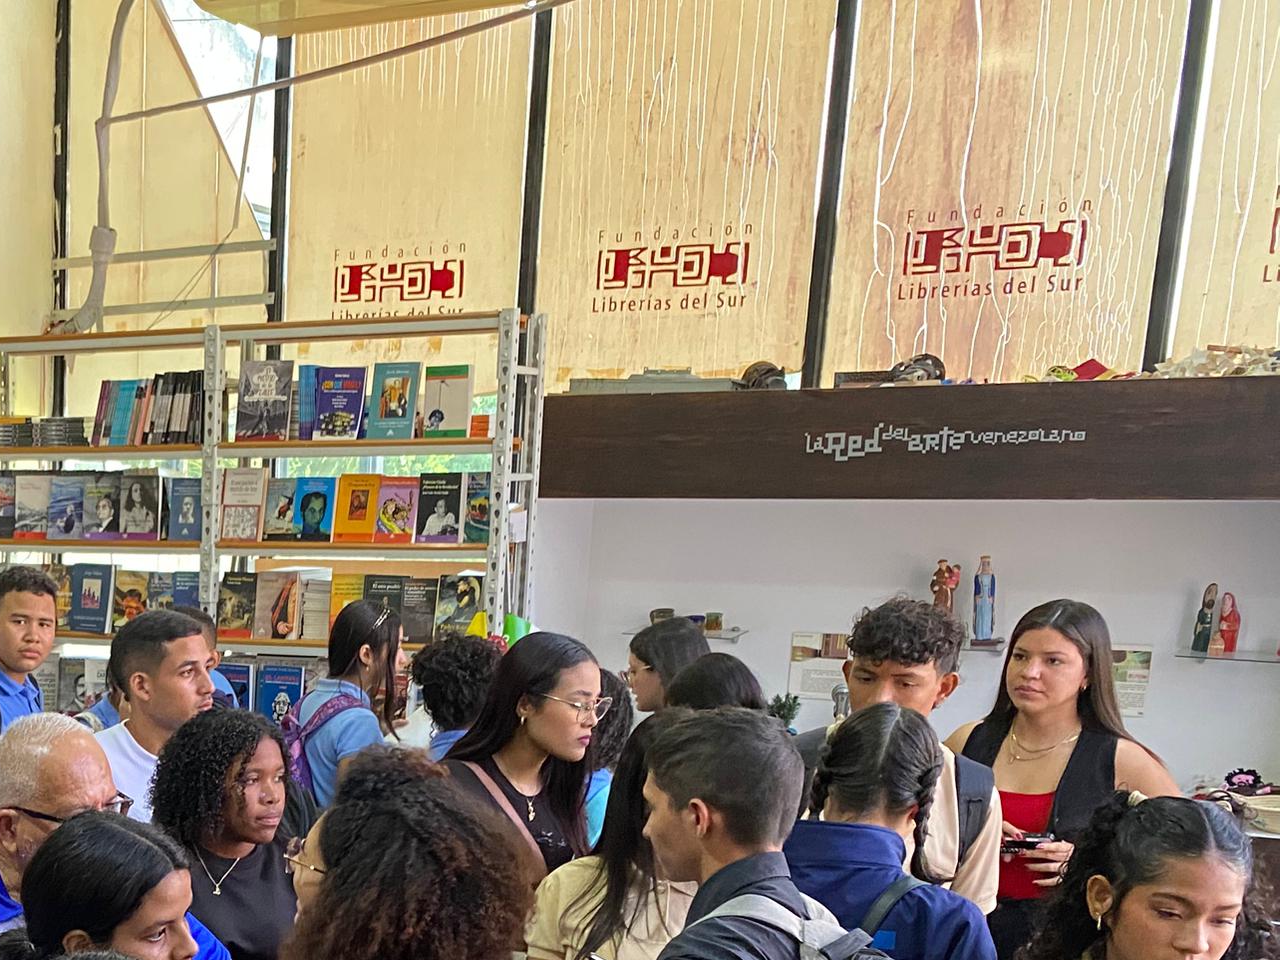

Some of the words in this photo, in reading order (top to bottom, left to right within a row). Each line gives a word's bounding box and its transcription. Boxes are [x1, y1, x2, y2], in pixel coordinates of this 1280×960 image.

[907, 197, 1092, 224] Fundación
[598, 221, 753, 244] Fundación
[334, 240, 466, 261] Fundación
[898, 276, 992, 300] Librerías
[1003, 276, 1036, 294] del
[1047, 274, 1083, 292] Sur
[592, 294, 671, 313] Librerías
[680, 293, 708, 310] del
[716, 292, 747, 308] Sur
